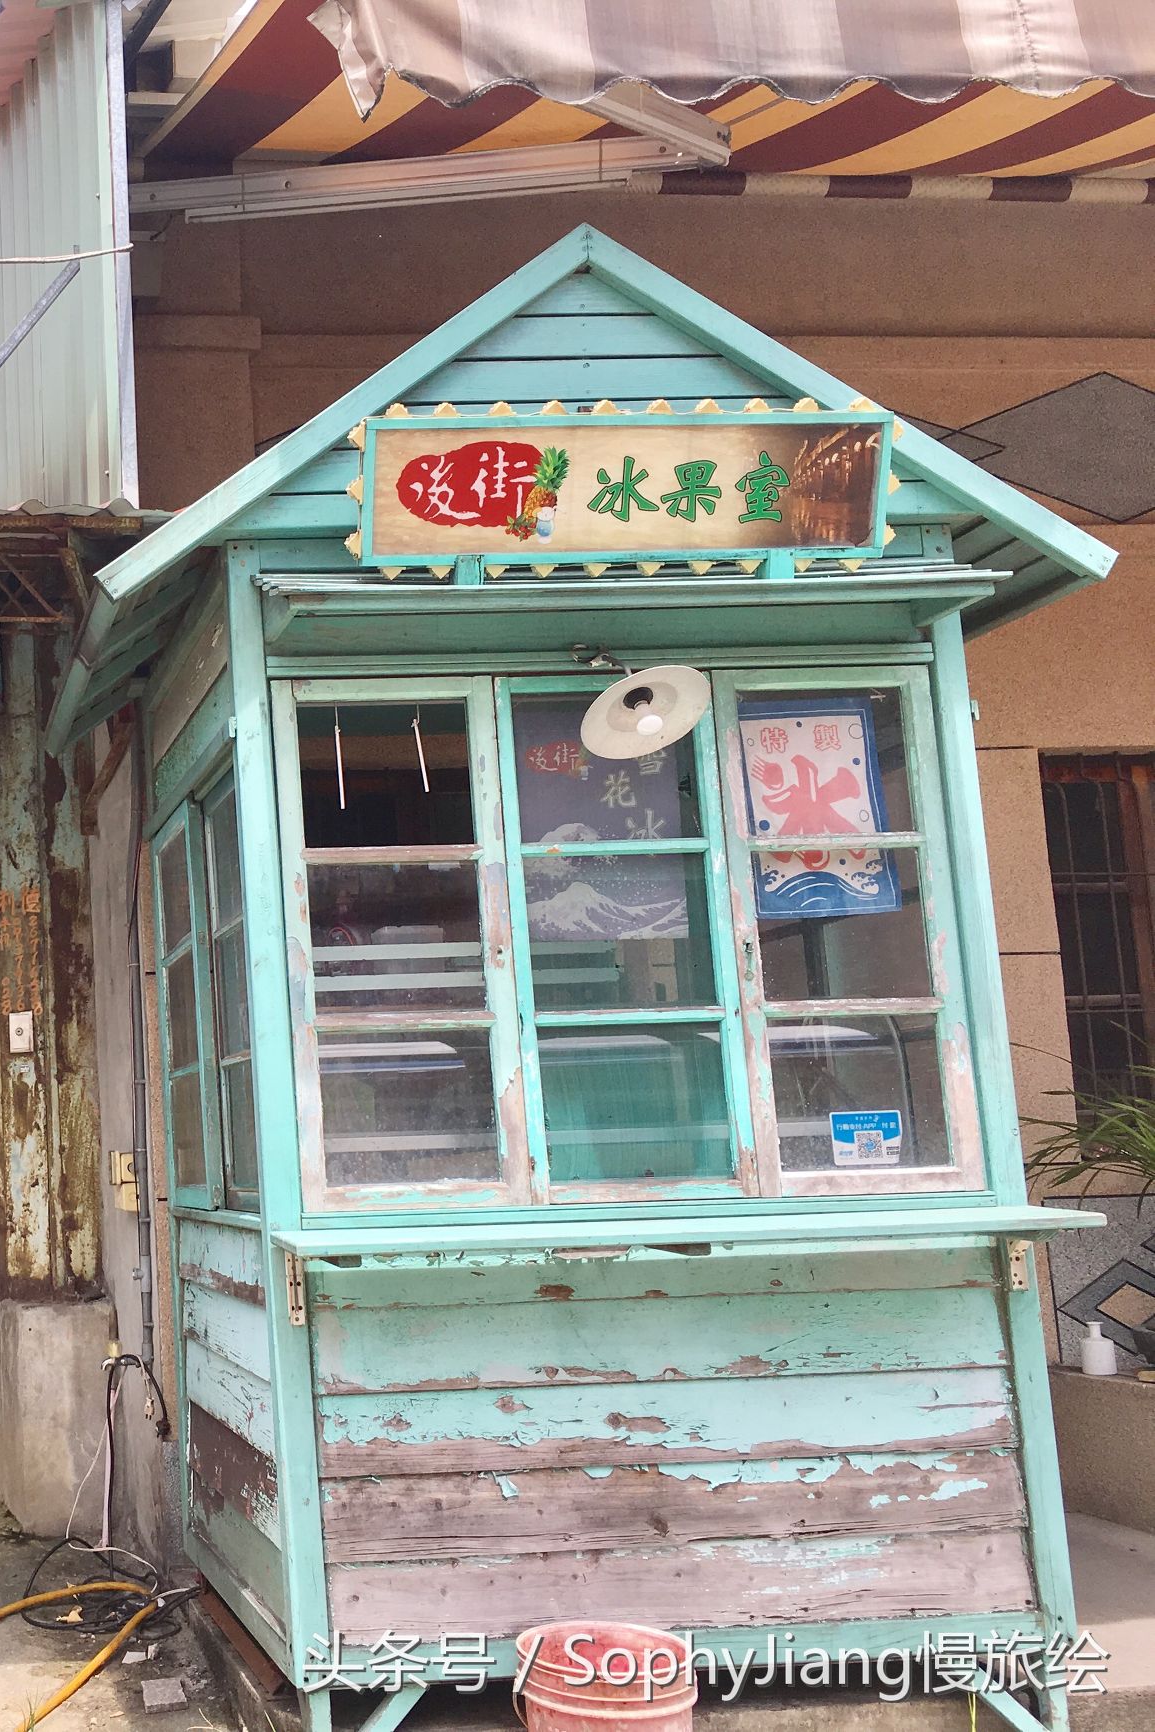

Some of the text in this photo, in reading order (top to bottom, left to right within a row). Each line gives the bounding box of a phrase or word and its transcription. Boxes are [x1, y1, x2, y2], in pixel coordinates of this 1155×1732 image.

[587, 450, 791, 524] 冰果室
[760, 724, 842, 753] 特製
